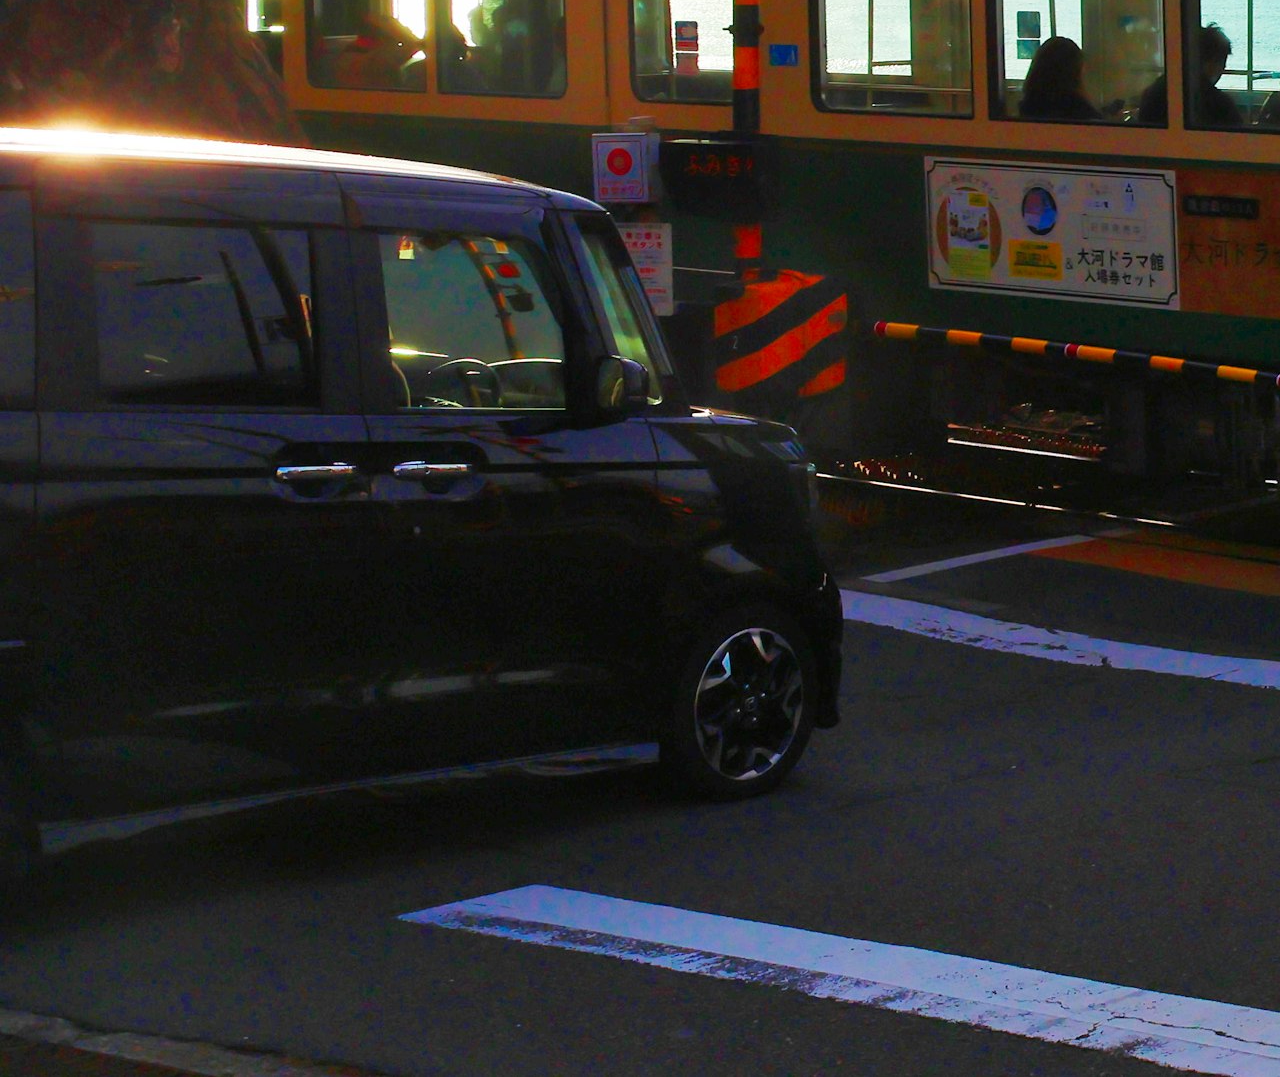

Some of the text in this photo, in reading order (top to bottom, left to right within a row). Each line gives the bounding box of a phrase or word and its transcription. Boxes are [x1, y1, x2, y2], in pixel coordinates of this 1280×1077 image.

[683, 153, 754, 178] ふみきり
[1077, 248, 1165, 271] 大河ドラマ館
[1085, 269, 1157, 288] 入場券セット
